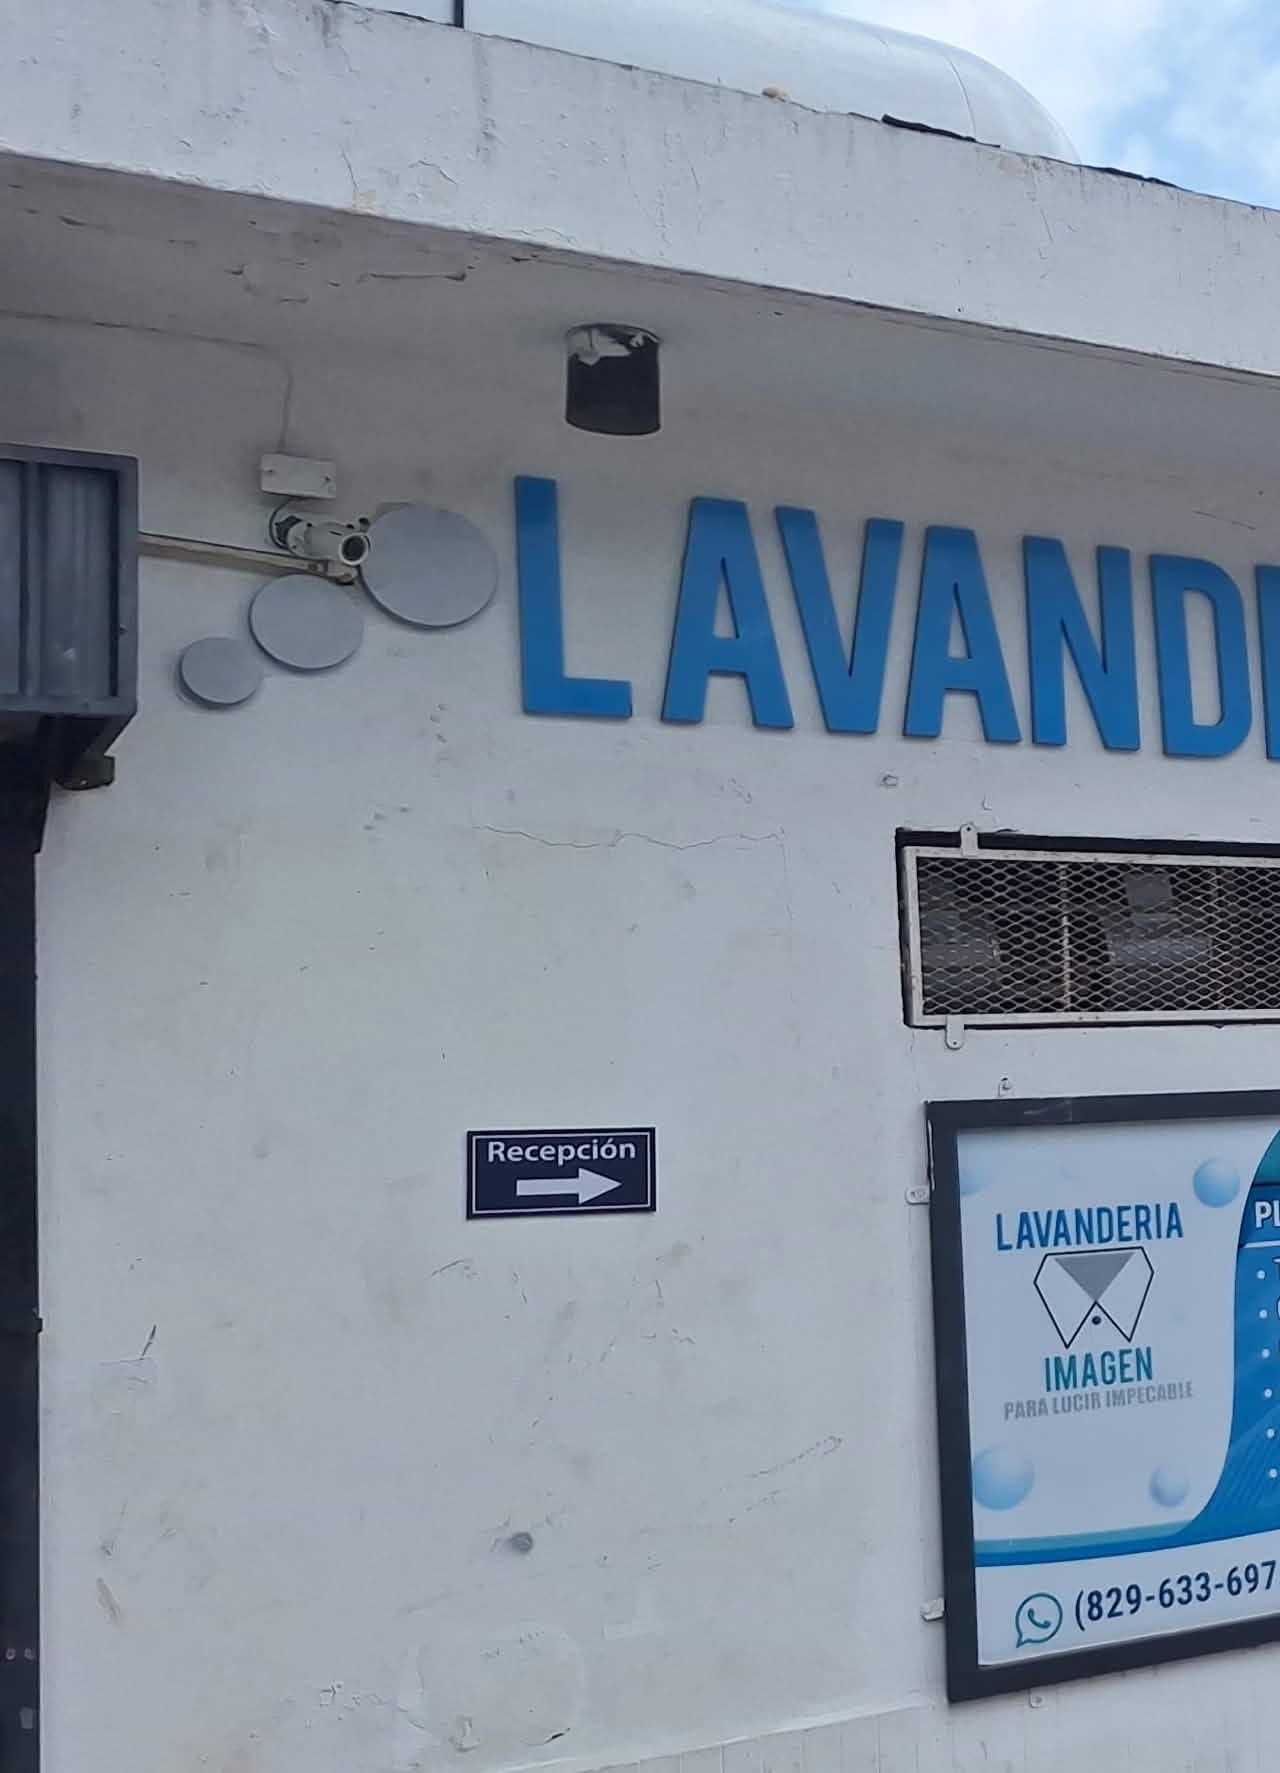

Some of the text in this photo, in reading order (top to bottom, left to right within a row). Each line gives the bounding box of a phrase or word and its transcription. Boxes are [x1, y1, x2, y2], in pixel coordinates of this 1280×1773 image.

[488, 1138, 635, 1166] Recepción
[996, 1202, 1184, 1251] LAVANDERIA
[1044, 1346, 1153, 1392] IMAGEN
[1004, 1380, 1193, 1421] PARA LUCIR IMPECABLE
